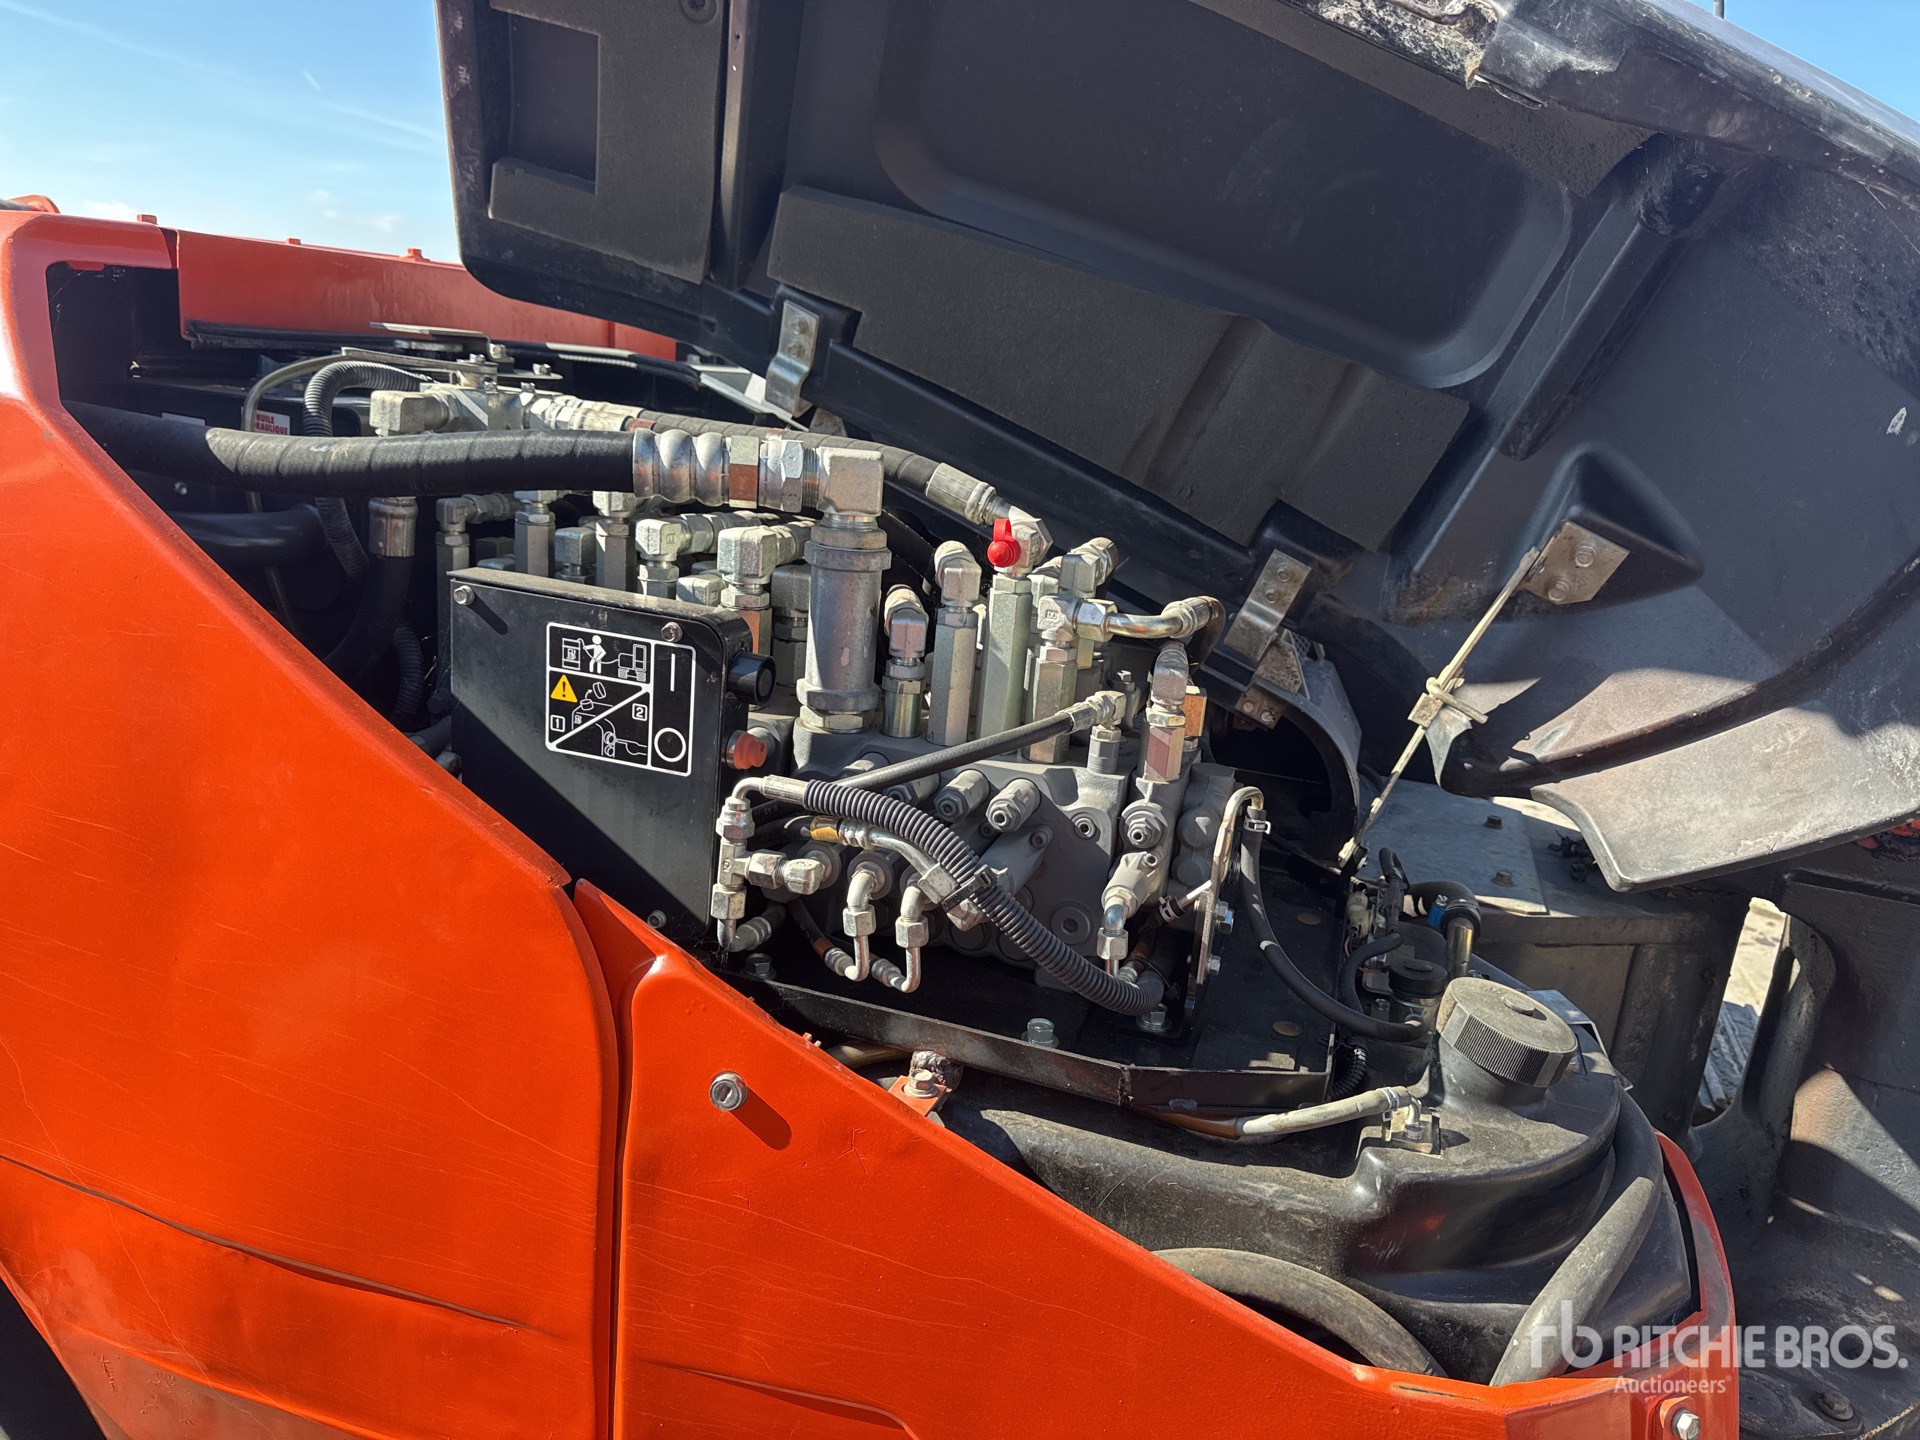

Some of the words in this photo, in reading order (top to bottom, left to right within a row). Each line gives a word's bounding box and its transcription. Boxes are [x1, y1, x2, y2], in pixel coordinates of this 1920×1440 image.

[256, 414, 275, 424] HUILE
[256, 422, 288, 435] RAULIQUE
[636, 707, 645, 718] 2
